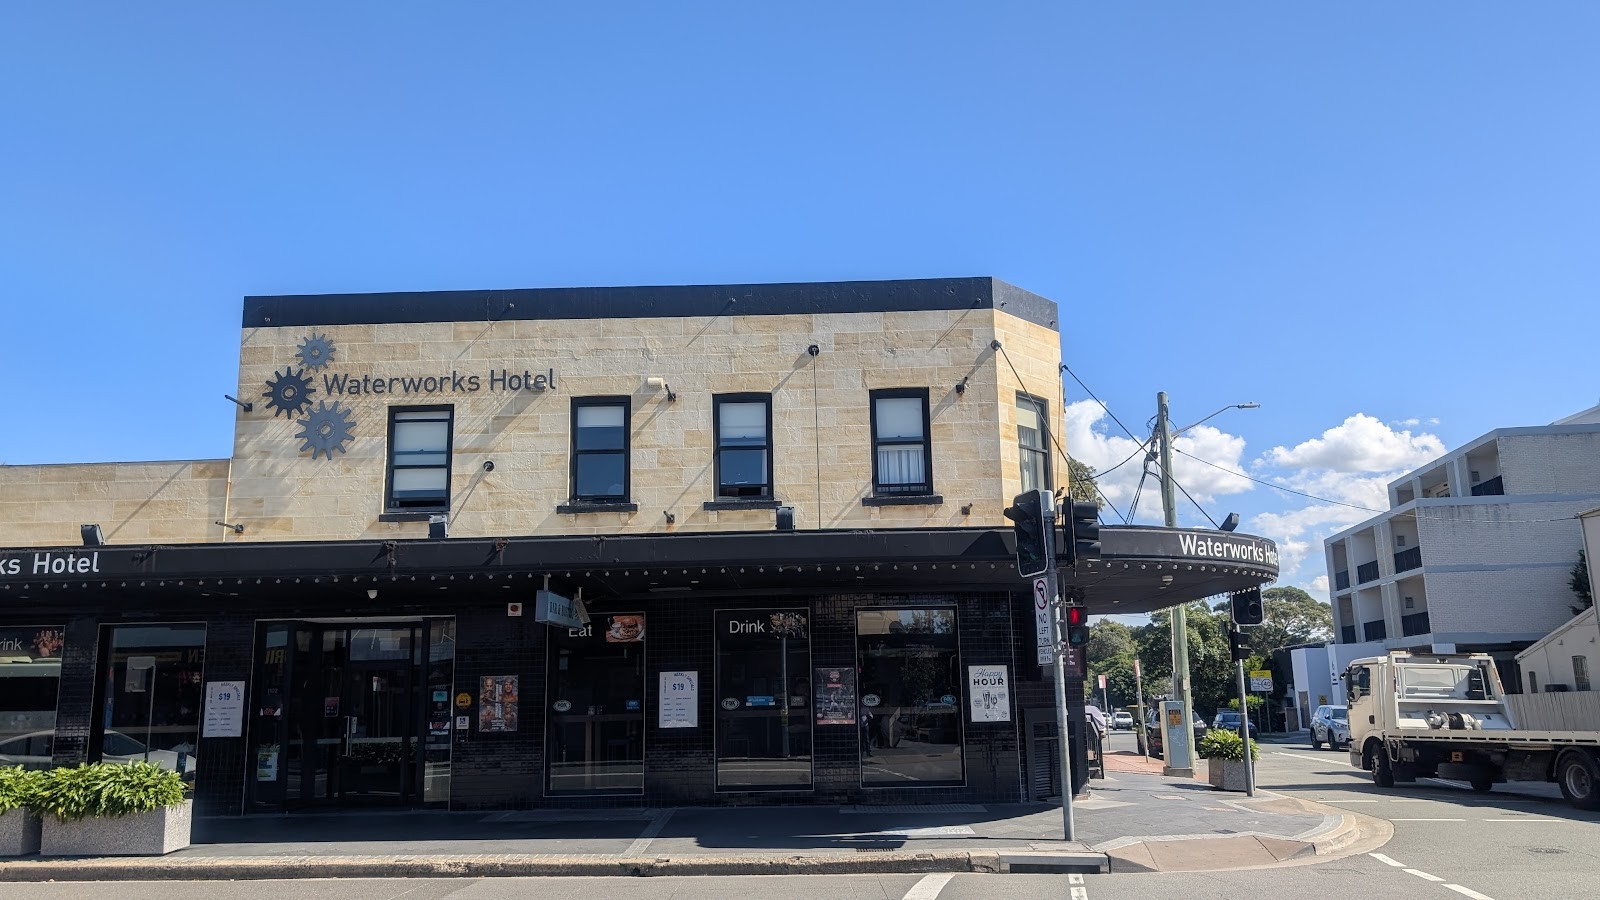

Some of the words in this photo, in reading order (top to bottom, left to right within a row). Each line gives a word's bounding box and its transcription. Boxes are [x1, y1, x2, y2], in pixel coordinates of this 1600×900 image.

[323, 370, 481, 396] Waterworks
[490, 367, 556, 392] Hotel
[1178, 534, 1264, 562] Waterworks
[33, 552, 100, 574] Hotel
[1038, 613, 1048, 625] NO
[568, 624, 593, 638] Eat
[729, 619, 766, 634] Drink
[1039, 626, 1049, 635] LEFT
[1038, 637, 1050, 645] TURN
[973, 668, 1003, 680] Happy
[672, 683, 685, 691] $19
[973, 678, 1005, 686] HOUR
[218, 692, 231, 701] $19
